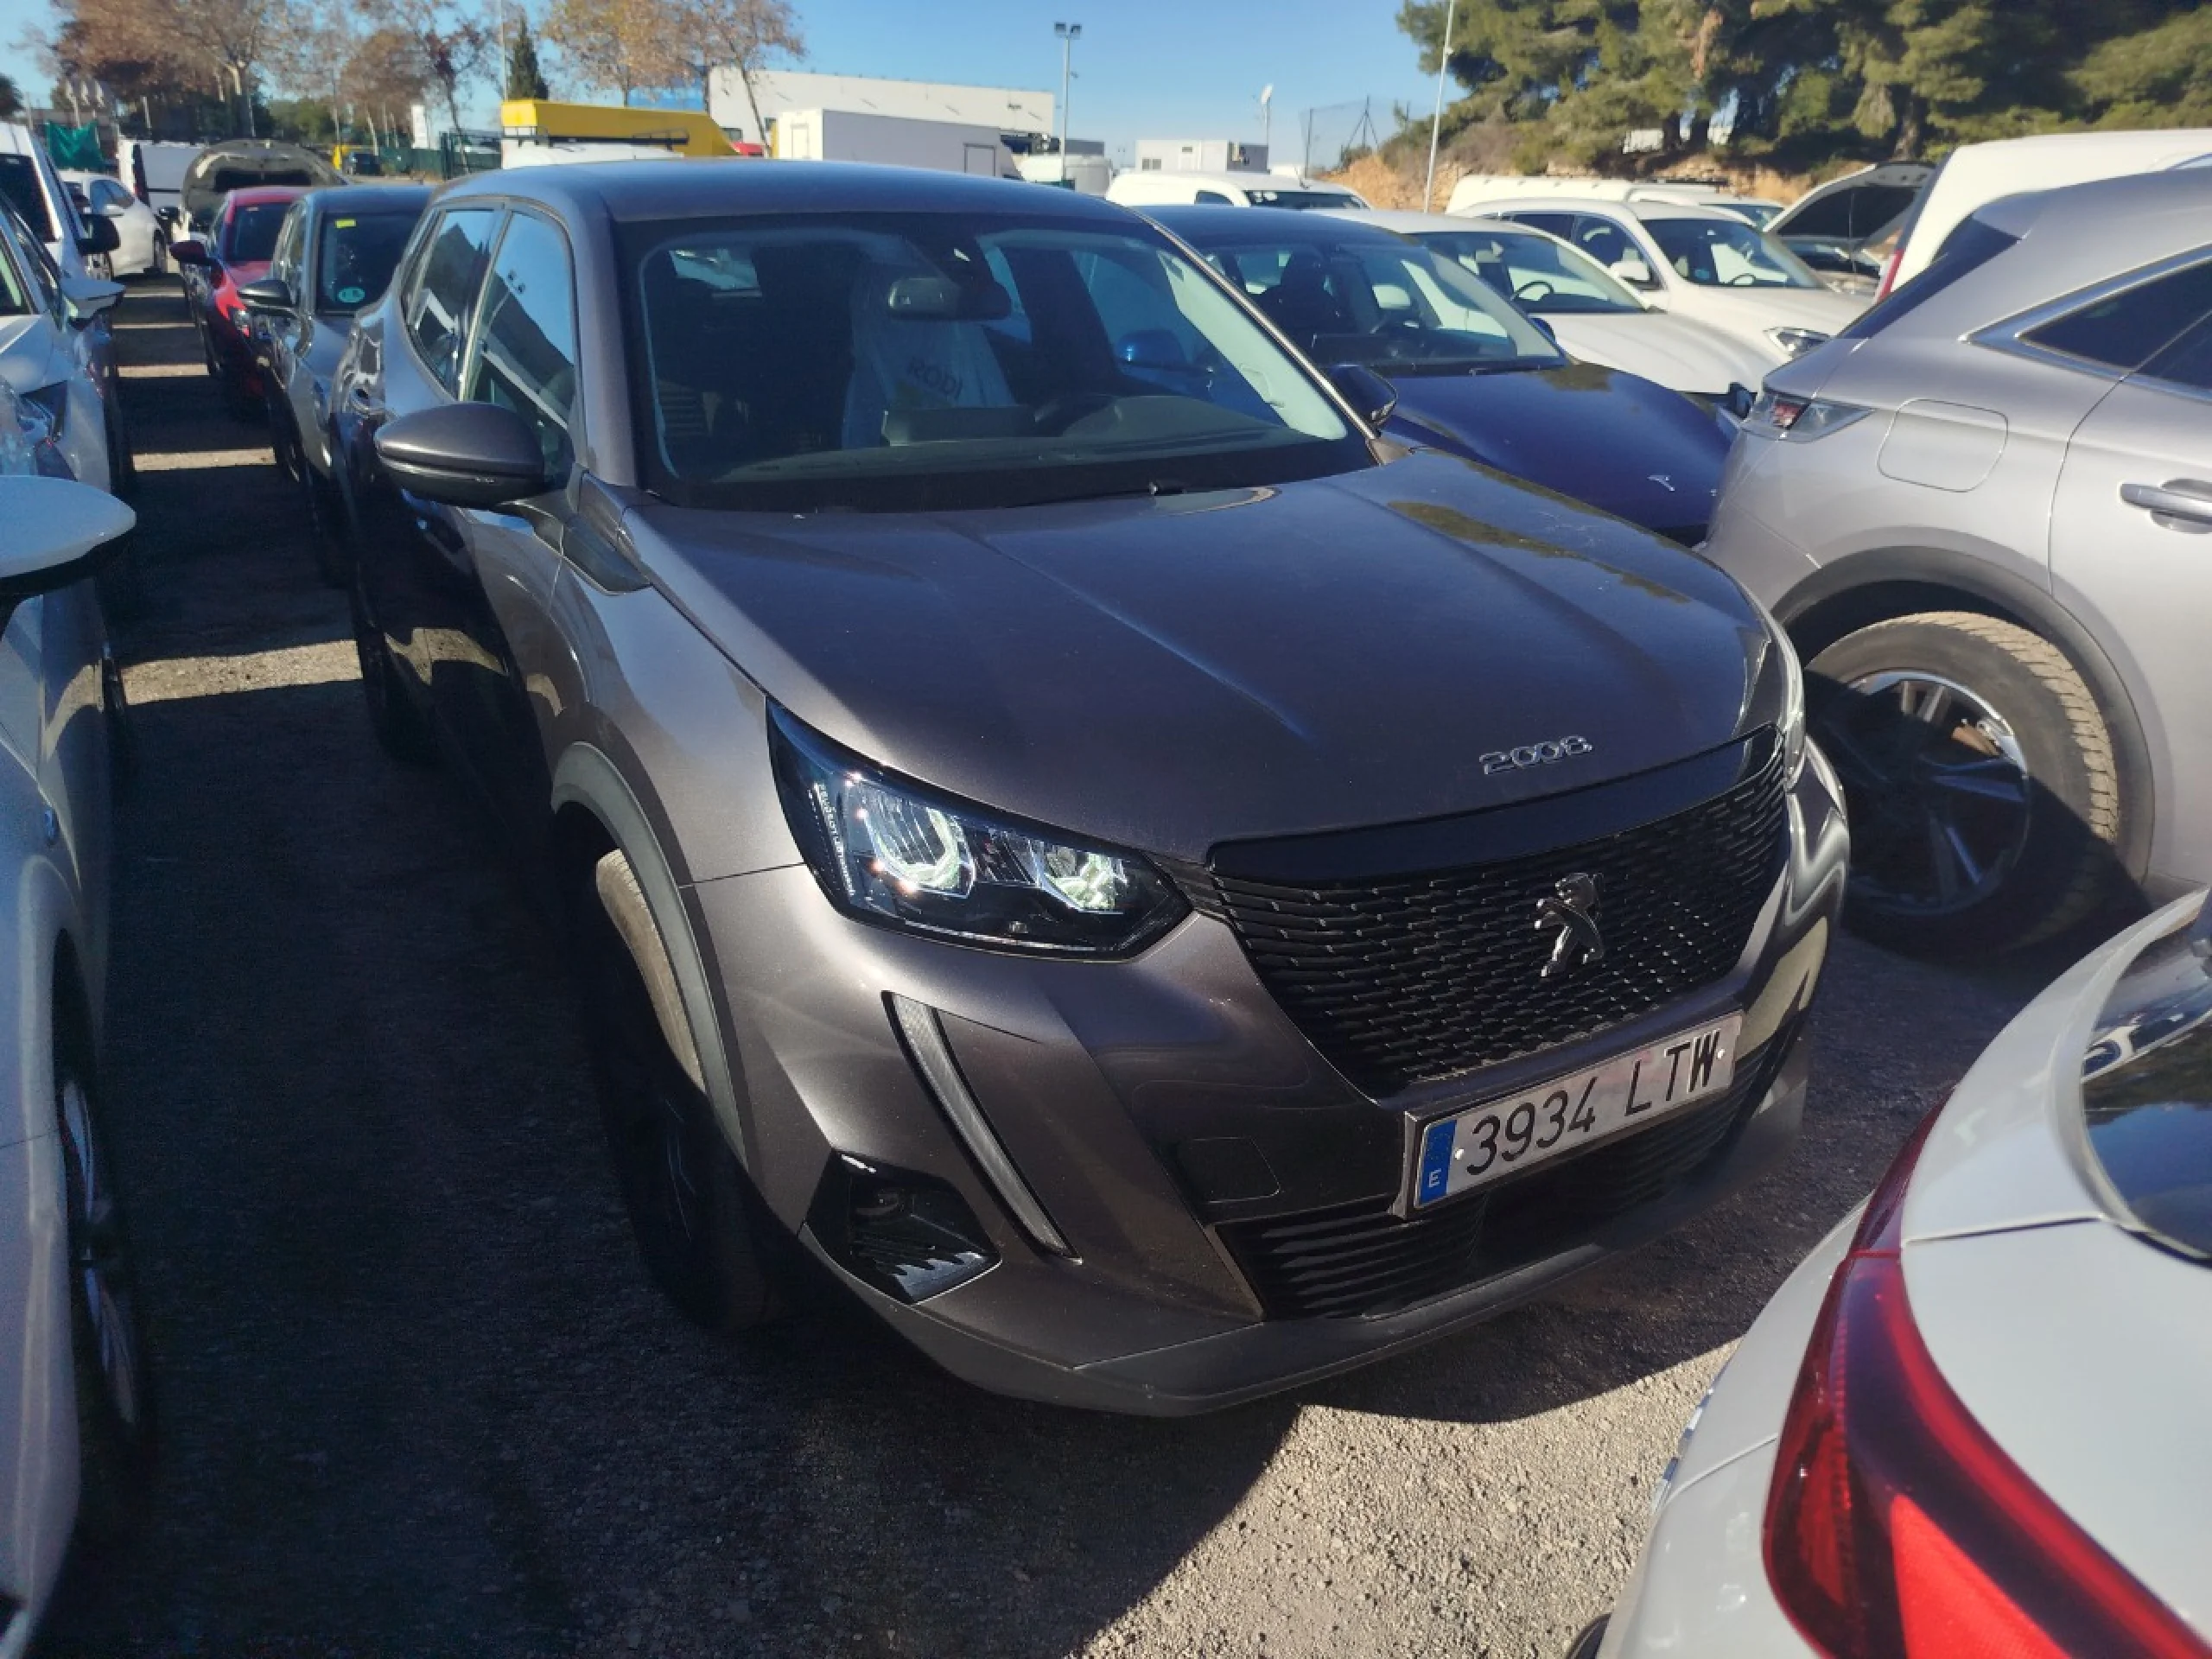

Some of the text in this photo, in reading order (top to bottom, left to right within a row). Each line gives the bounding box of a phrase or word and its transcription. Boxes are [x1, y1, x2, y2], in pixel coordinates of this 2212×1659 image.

[1479, 735, 1592, 774] 2008
[1466, 1030, 1720, 1176] 3934 LTW
[1427, 1168, 1442, 1188] E
